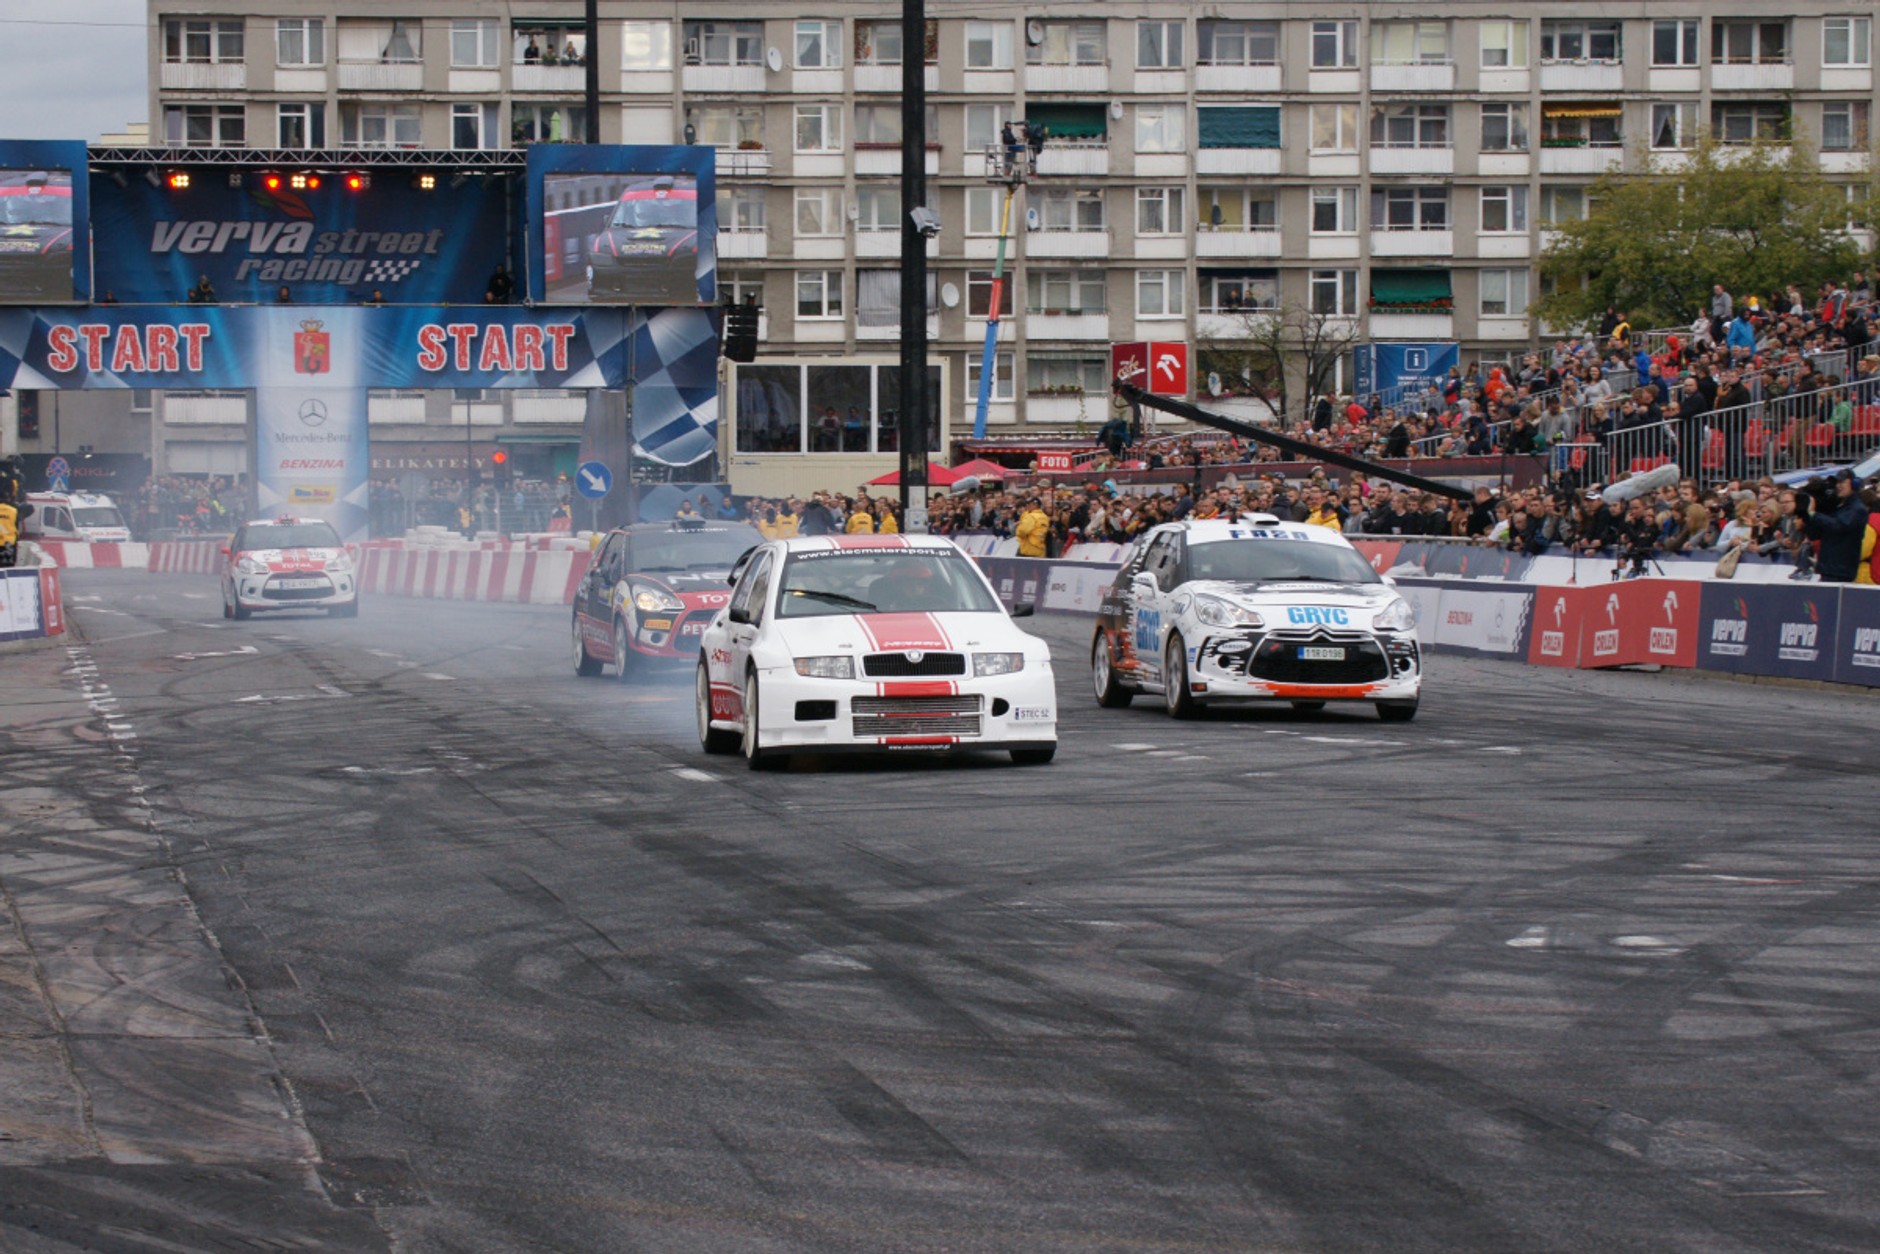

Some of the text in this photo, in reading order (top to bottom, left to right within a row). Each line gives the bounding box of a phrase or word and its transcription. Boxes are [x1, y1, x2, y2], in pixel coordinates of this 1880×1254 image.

[151, 221, 444, 254] verva street
[235, 255, 366, 285] racing
[48, 324, 211, 372] START
[417, 323, 575, 371] START
[280, 458, 345, 469] BENZINA
[371, 457, 486, 469] ELIKATESY
[1040, 456, 1070, 468] FOTO
[697, 594, 731, 604] TOT
[1287, 606, 1349, 625] GRYC
[1712, 619, 1747, 642] verva
[1780, 622, 1818, 647] verva
[1543, 633, 1562, 651] ORLEN
[1596, 632, 1617, 652] ORLEN
[1652, 631, 1676, 650] ORLEN
[1020, 709, 1040, 718] STEC
